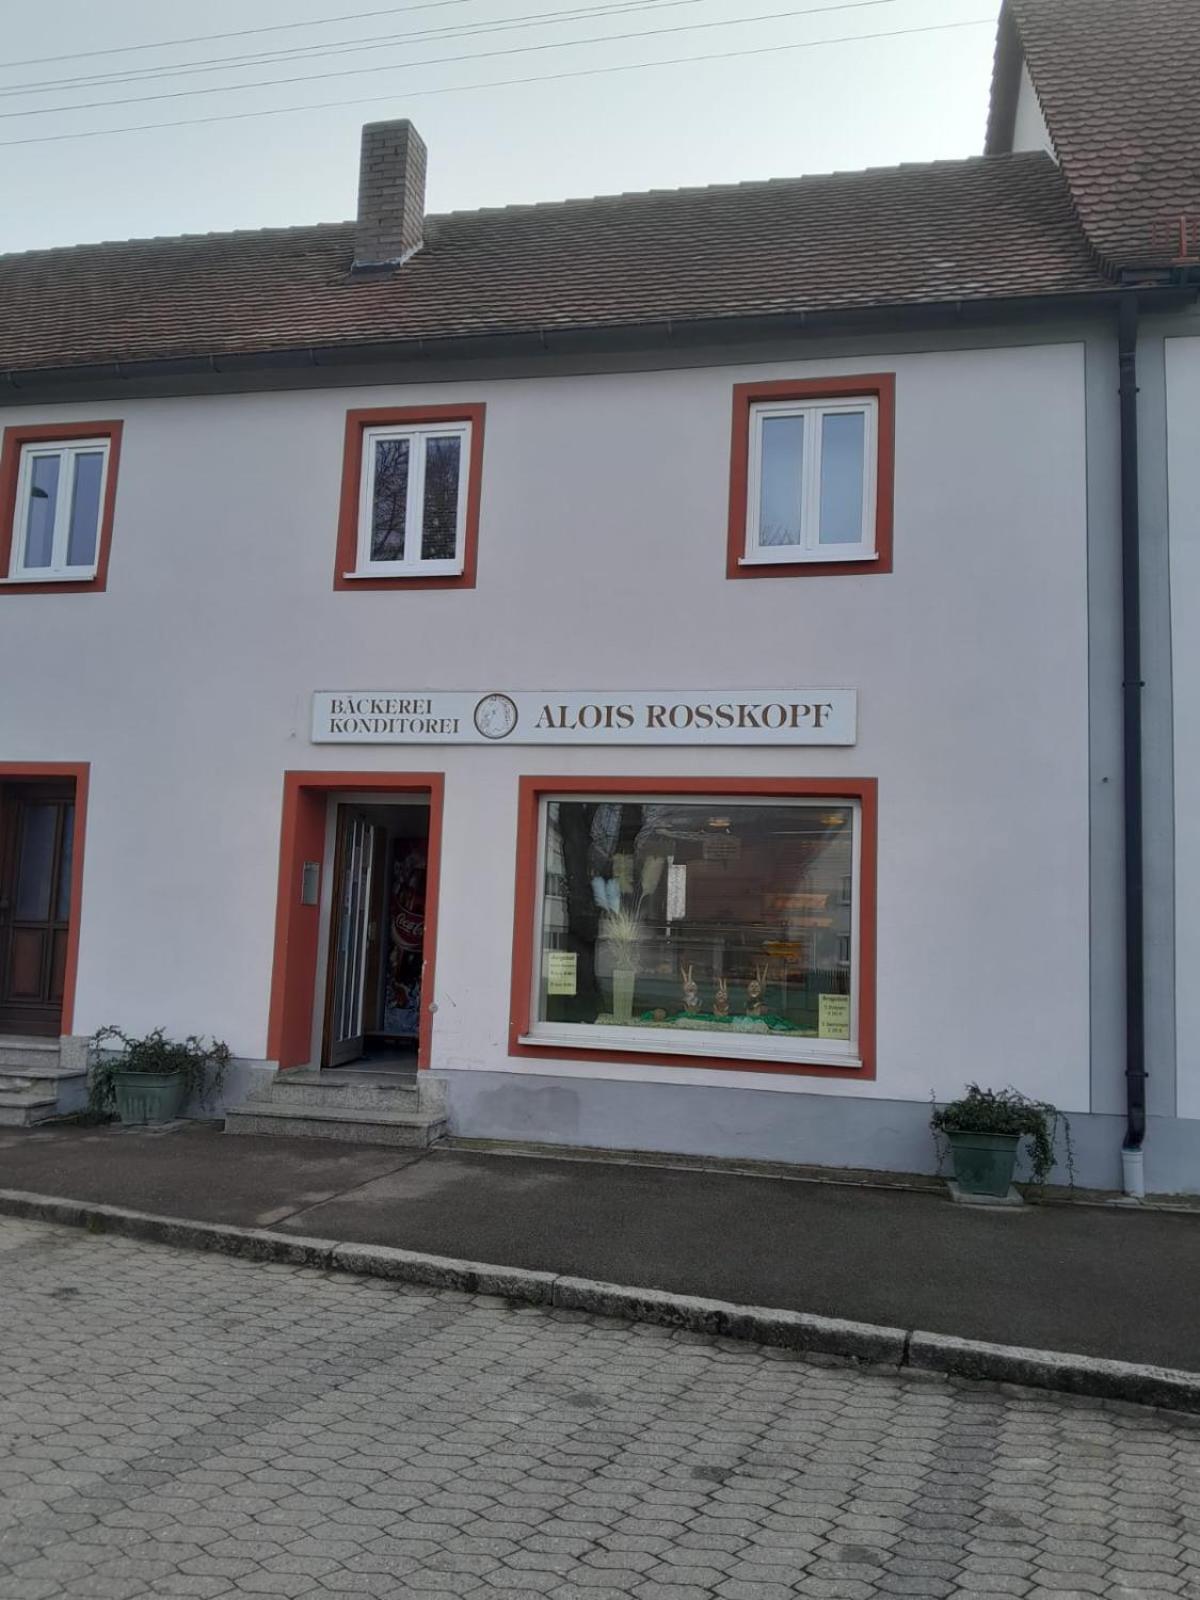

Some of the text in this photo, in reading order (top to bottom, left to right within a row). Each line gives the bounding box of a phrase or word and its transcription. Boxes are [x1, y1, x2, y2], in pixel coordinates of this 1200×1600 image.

[330, 696, 432, 714] BÄCKEREI
[534, 703, 833, 730] ALOIS ROSSKOPF
[330, 718, 460, 734] KONDITOREI
